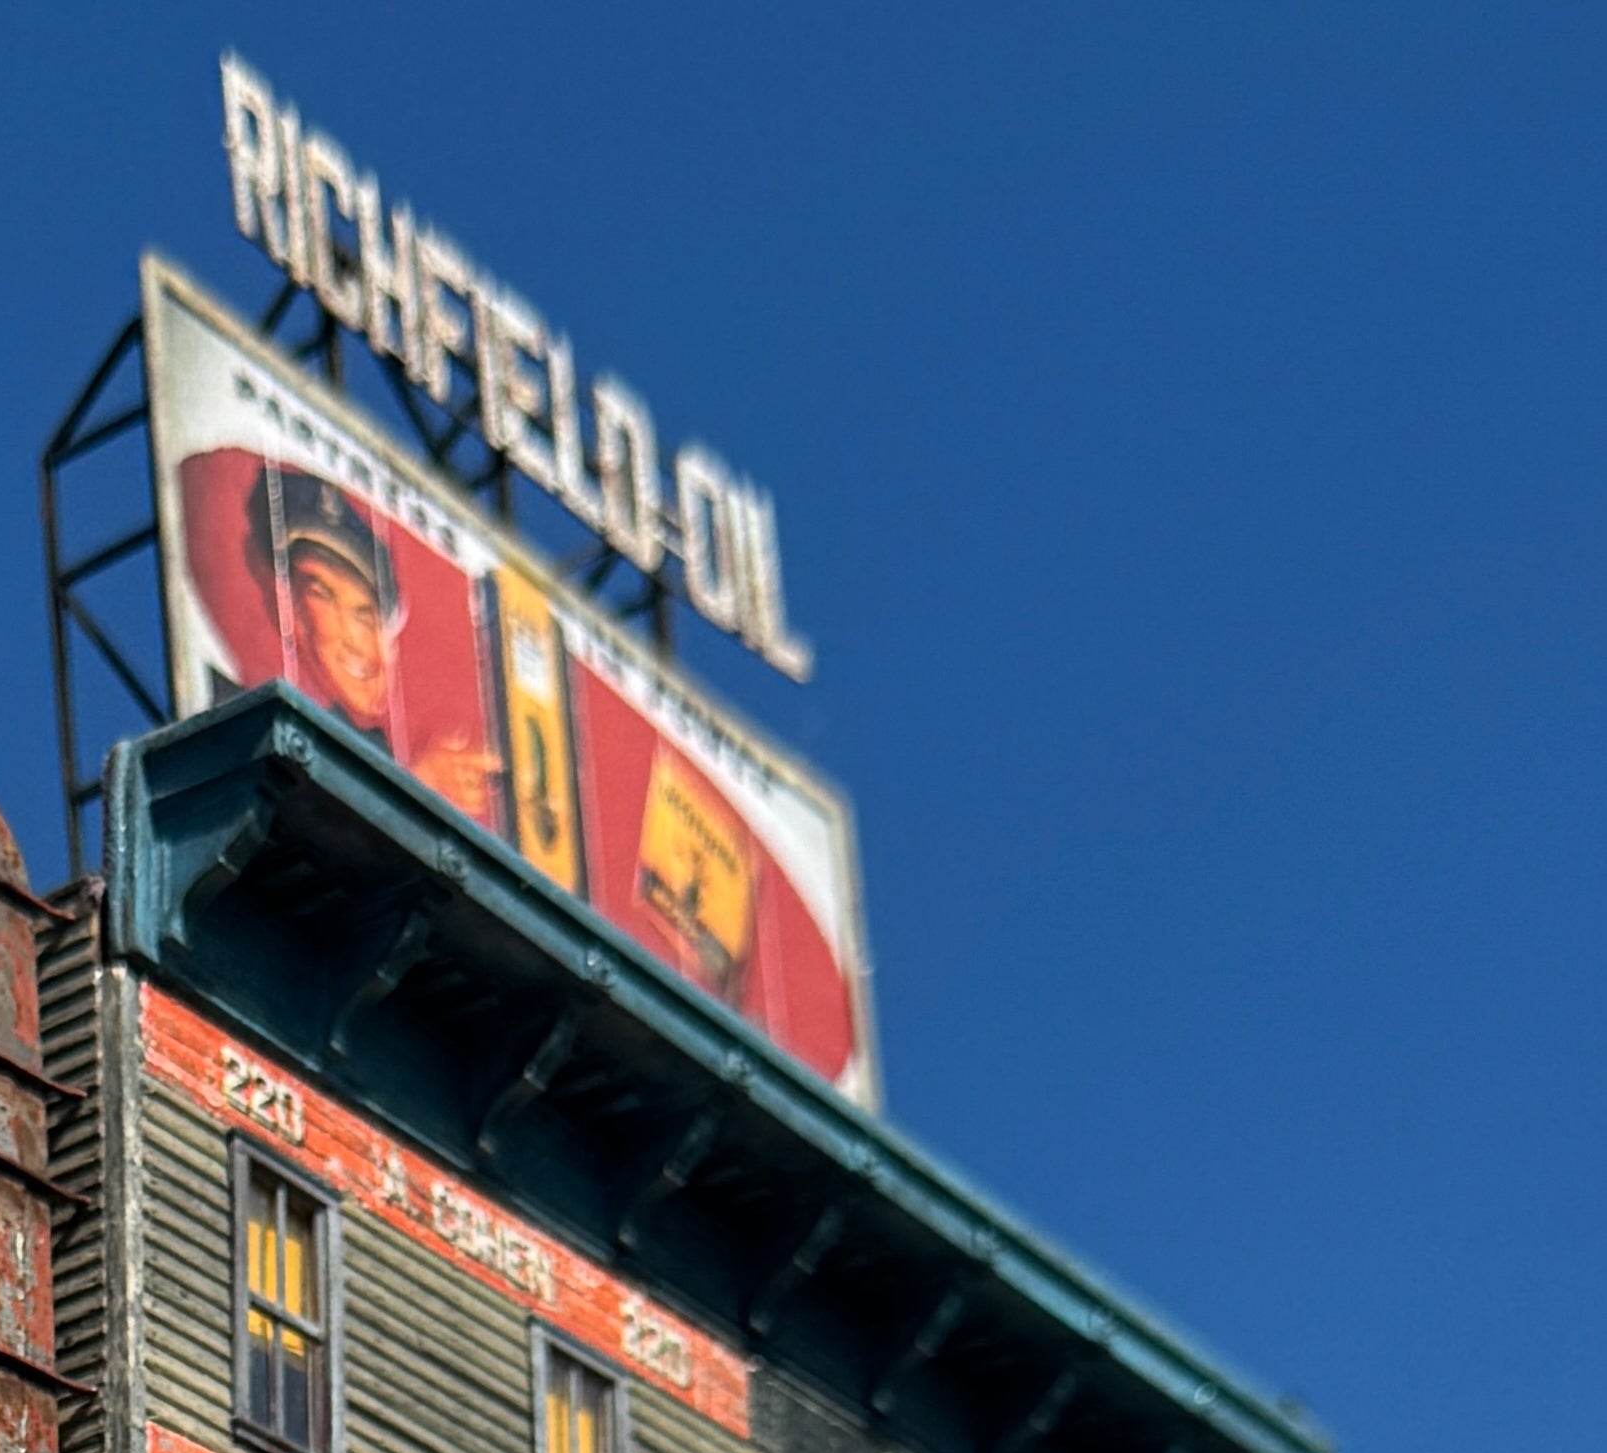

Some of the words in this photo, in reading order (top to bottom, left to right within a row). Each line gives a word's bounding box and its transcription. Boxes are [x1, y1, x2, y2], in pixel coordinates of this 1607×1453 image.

[220, 52, 662, 573] RICHFIELD
[675, 442, 814, 684] OIL
[220, 1046, 305, 1147] 220
